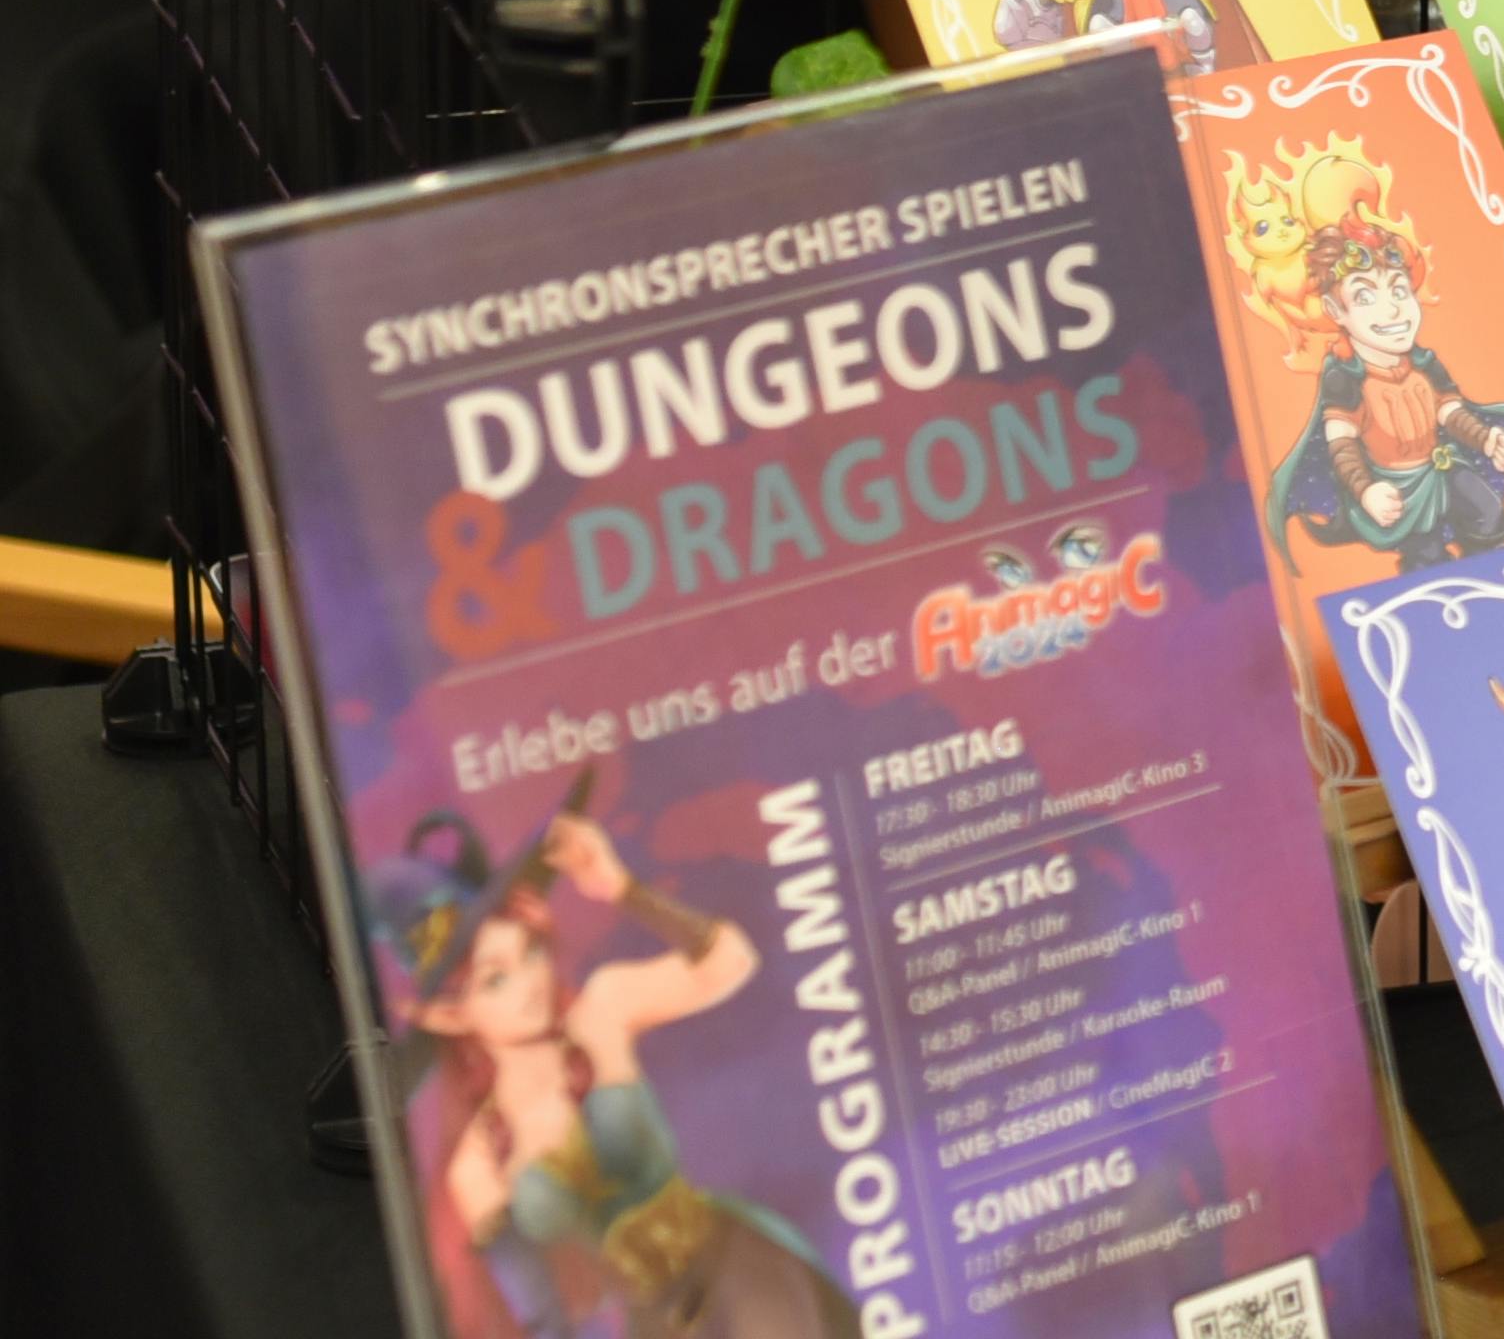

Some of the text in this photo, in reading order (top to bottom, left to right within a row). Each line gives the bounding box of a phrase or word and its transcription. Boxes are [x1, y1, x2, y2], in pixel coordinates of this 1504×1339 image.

[366, 159, 1088, 377] SYNCHRONSPRECHER SPIELEN
[446, 243, 1116, 503] DUNGEONS
[425, 378, 1141, 663] & DRAGONS
[451, 536, 1168, 794] Erlebe uns auf der AnimagiC
[976, 616, 1092, 679] 2024
[863, 720, 1025, 800] FREITAG
[945, 776, 1000, 814] 18:30
[1000, 765, 1039, 798] Uhr
[879, 805, 1023, 874] Signierstunde
[1191, 748, 1208, 774] 3
[890, 851, 1077, 945] SAMSTAG
[1029, 908, 1070, 941] Uhr
[923, 1027, 1067, 1096] Signierstunde
[1081, 973, 1227, 1039] Karaoke-Raum
[1044, 983, 1084, 1017] Uhr
[758, 779, 926, 1339] PROGRAMM
[1059, 1060, 1100, 1092] Uhr
[937, 1095, 1096, 1169] LIVE-SESSION
[1217, 1049, 1233, 1073] 2
[948, 1146, 1137, 1245] SONNTAG
[1087, 1205, 1126, 1237] Uhr
